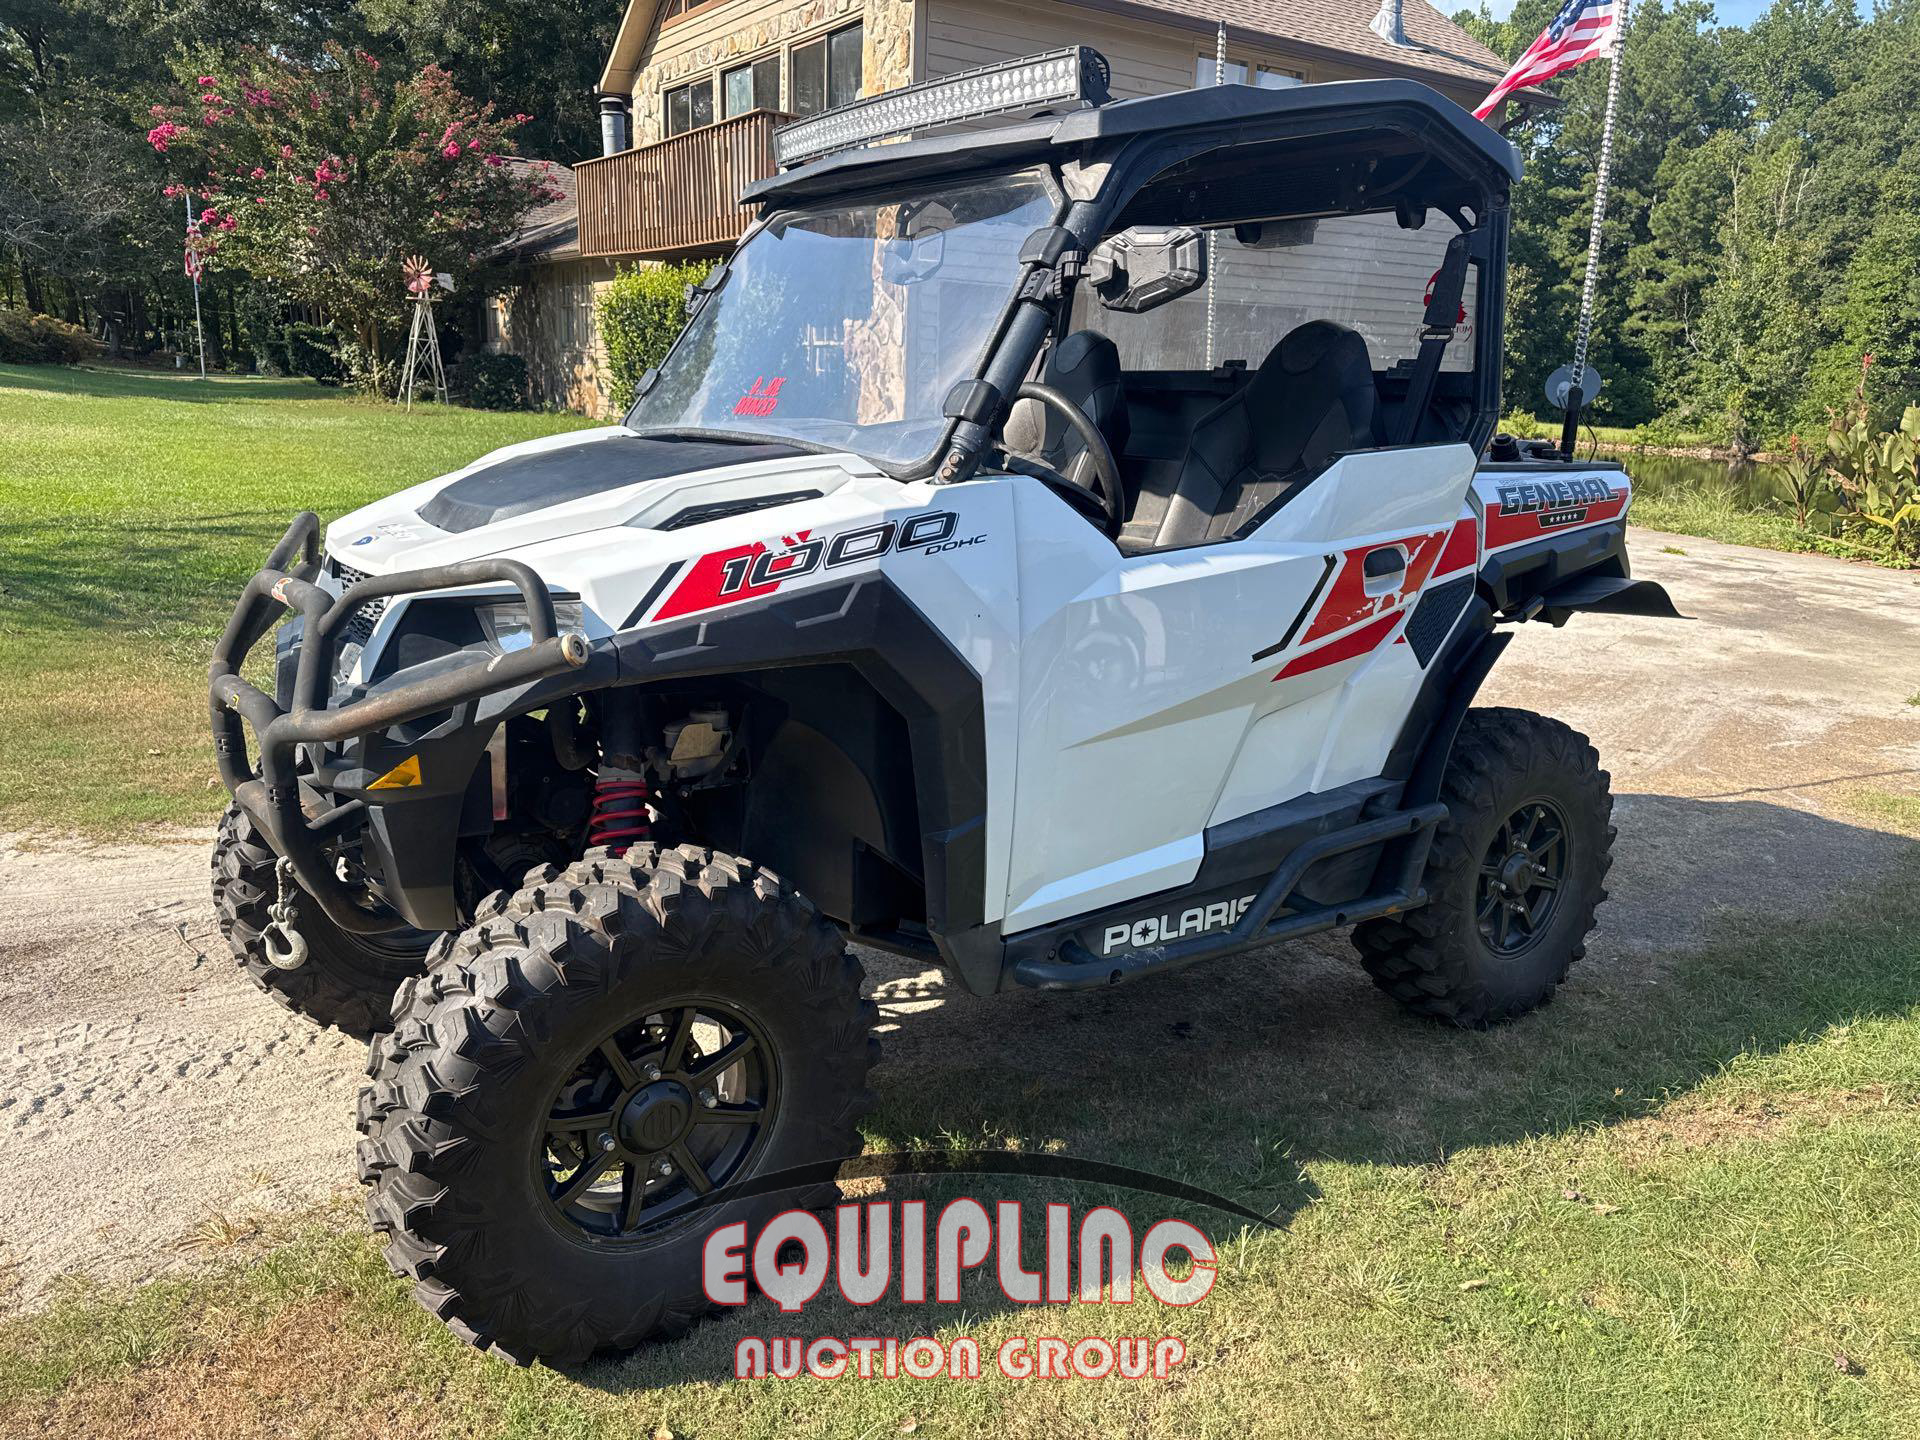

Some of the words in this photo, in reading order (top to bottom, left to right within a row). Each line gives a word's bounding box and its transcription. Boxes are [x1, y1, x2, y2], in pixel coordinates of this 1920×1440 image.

[1496, 477, 1619, 517] GENERAL
[719, 510, 960, 597] 1000
[925, 534, 987, 556] DOHC
